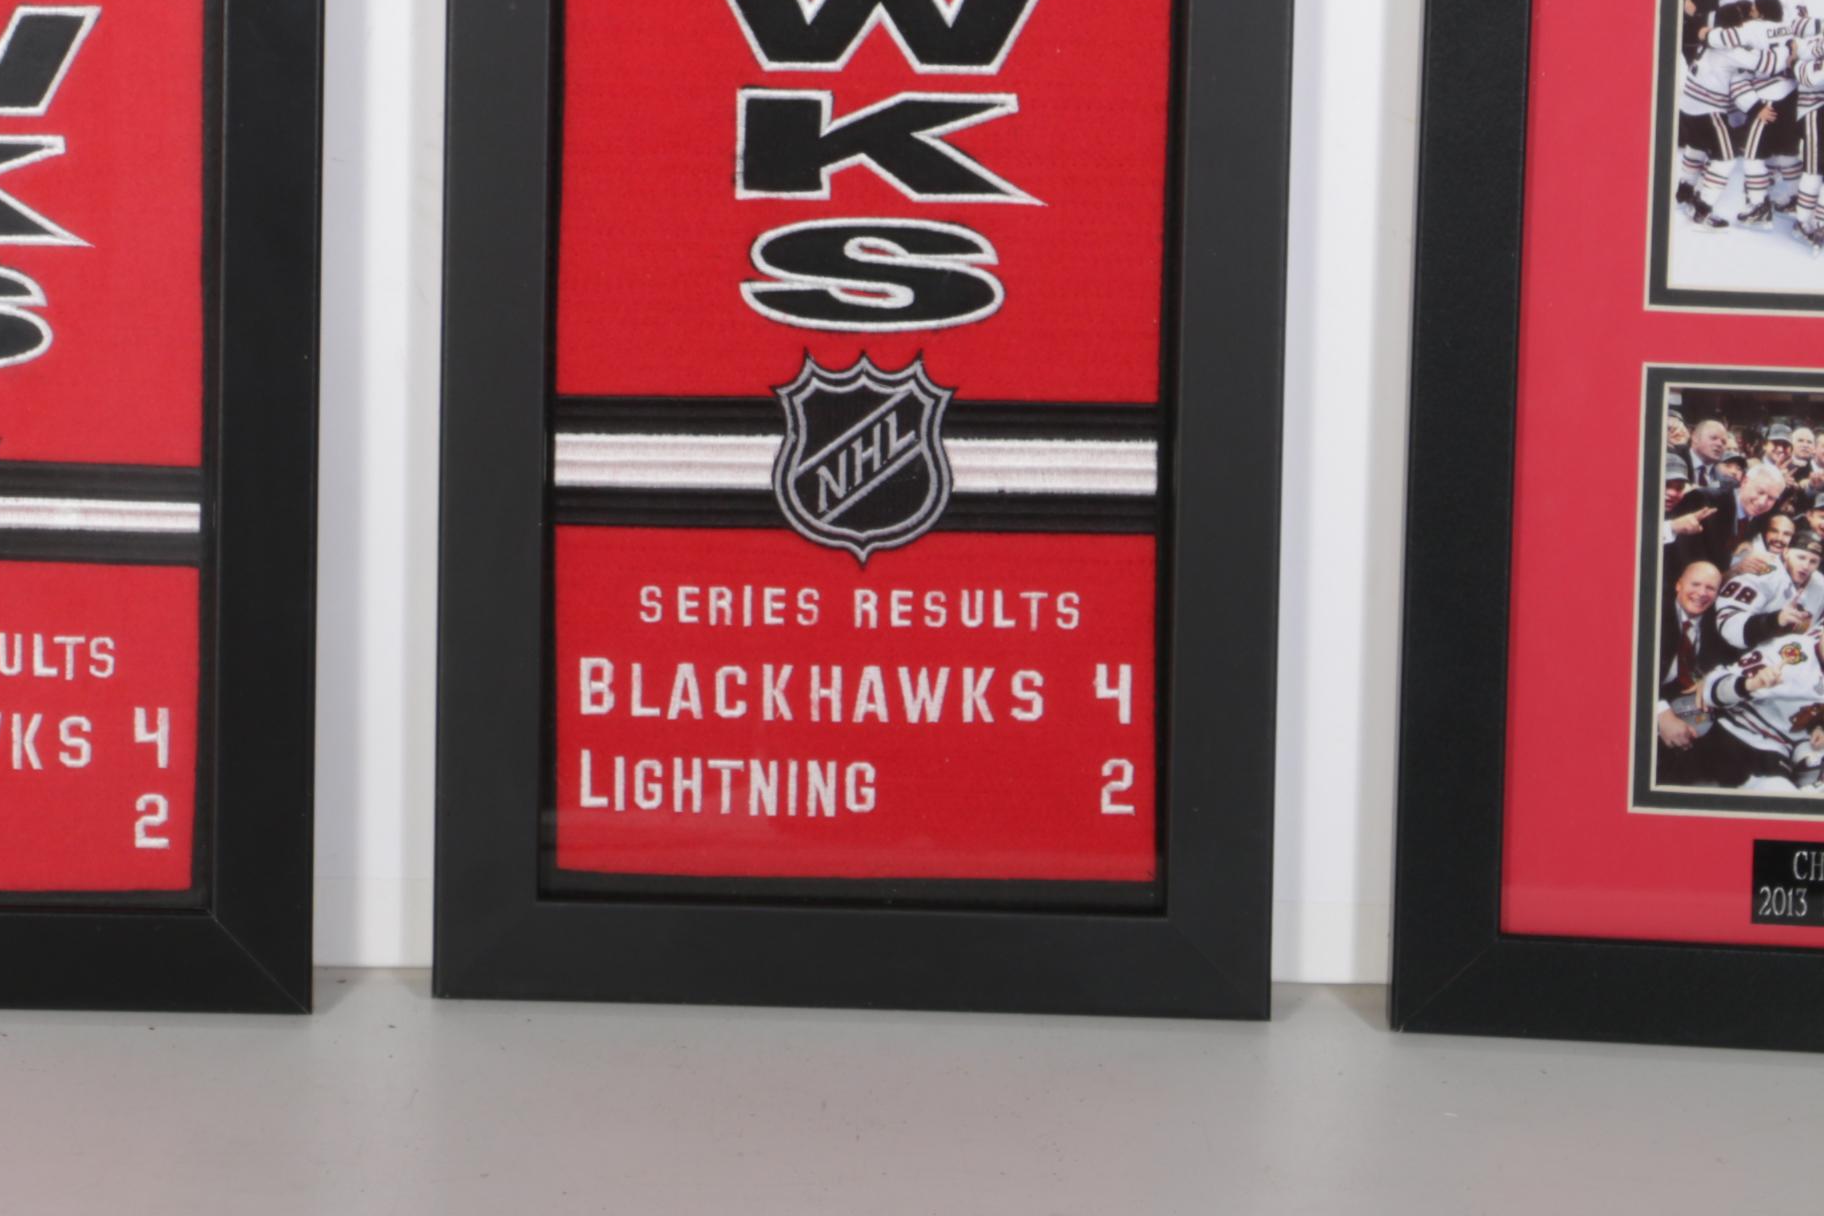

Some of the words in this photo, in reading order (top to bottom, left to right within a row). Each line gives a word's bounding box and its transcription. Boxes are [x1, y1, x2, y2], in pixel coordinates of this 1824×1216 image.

[816, 410, 917, 513] NHL
[641, 586, 818, 625] SERIES
[855, 590, 1078, 628] RESULTS
[581, 658, 1042, 722] BLACKHAWKS
[1096, 665, 1131, 723] 4
[135, 708, 168, 768] 4
[581, 750, 874, 816] LIGHTNING
[1102, 760, 1133, 813] 2
[135, 794, 168, 847] 2
[1759, 885, 1808, 916] 2013
